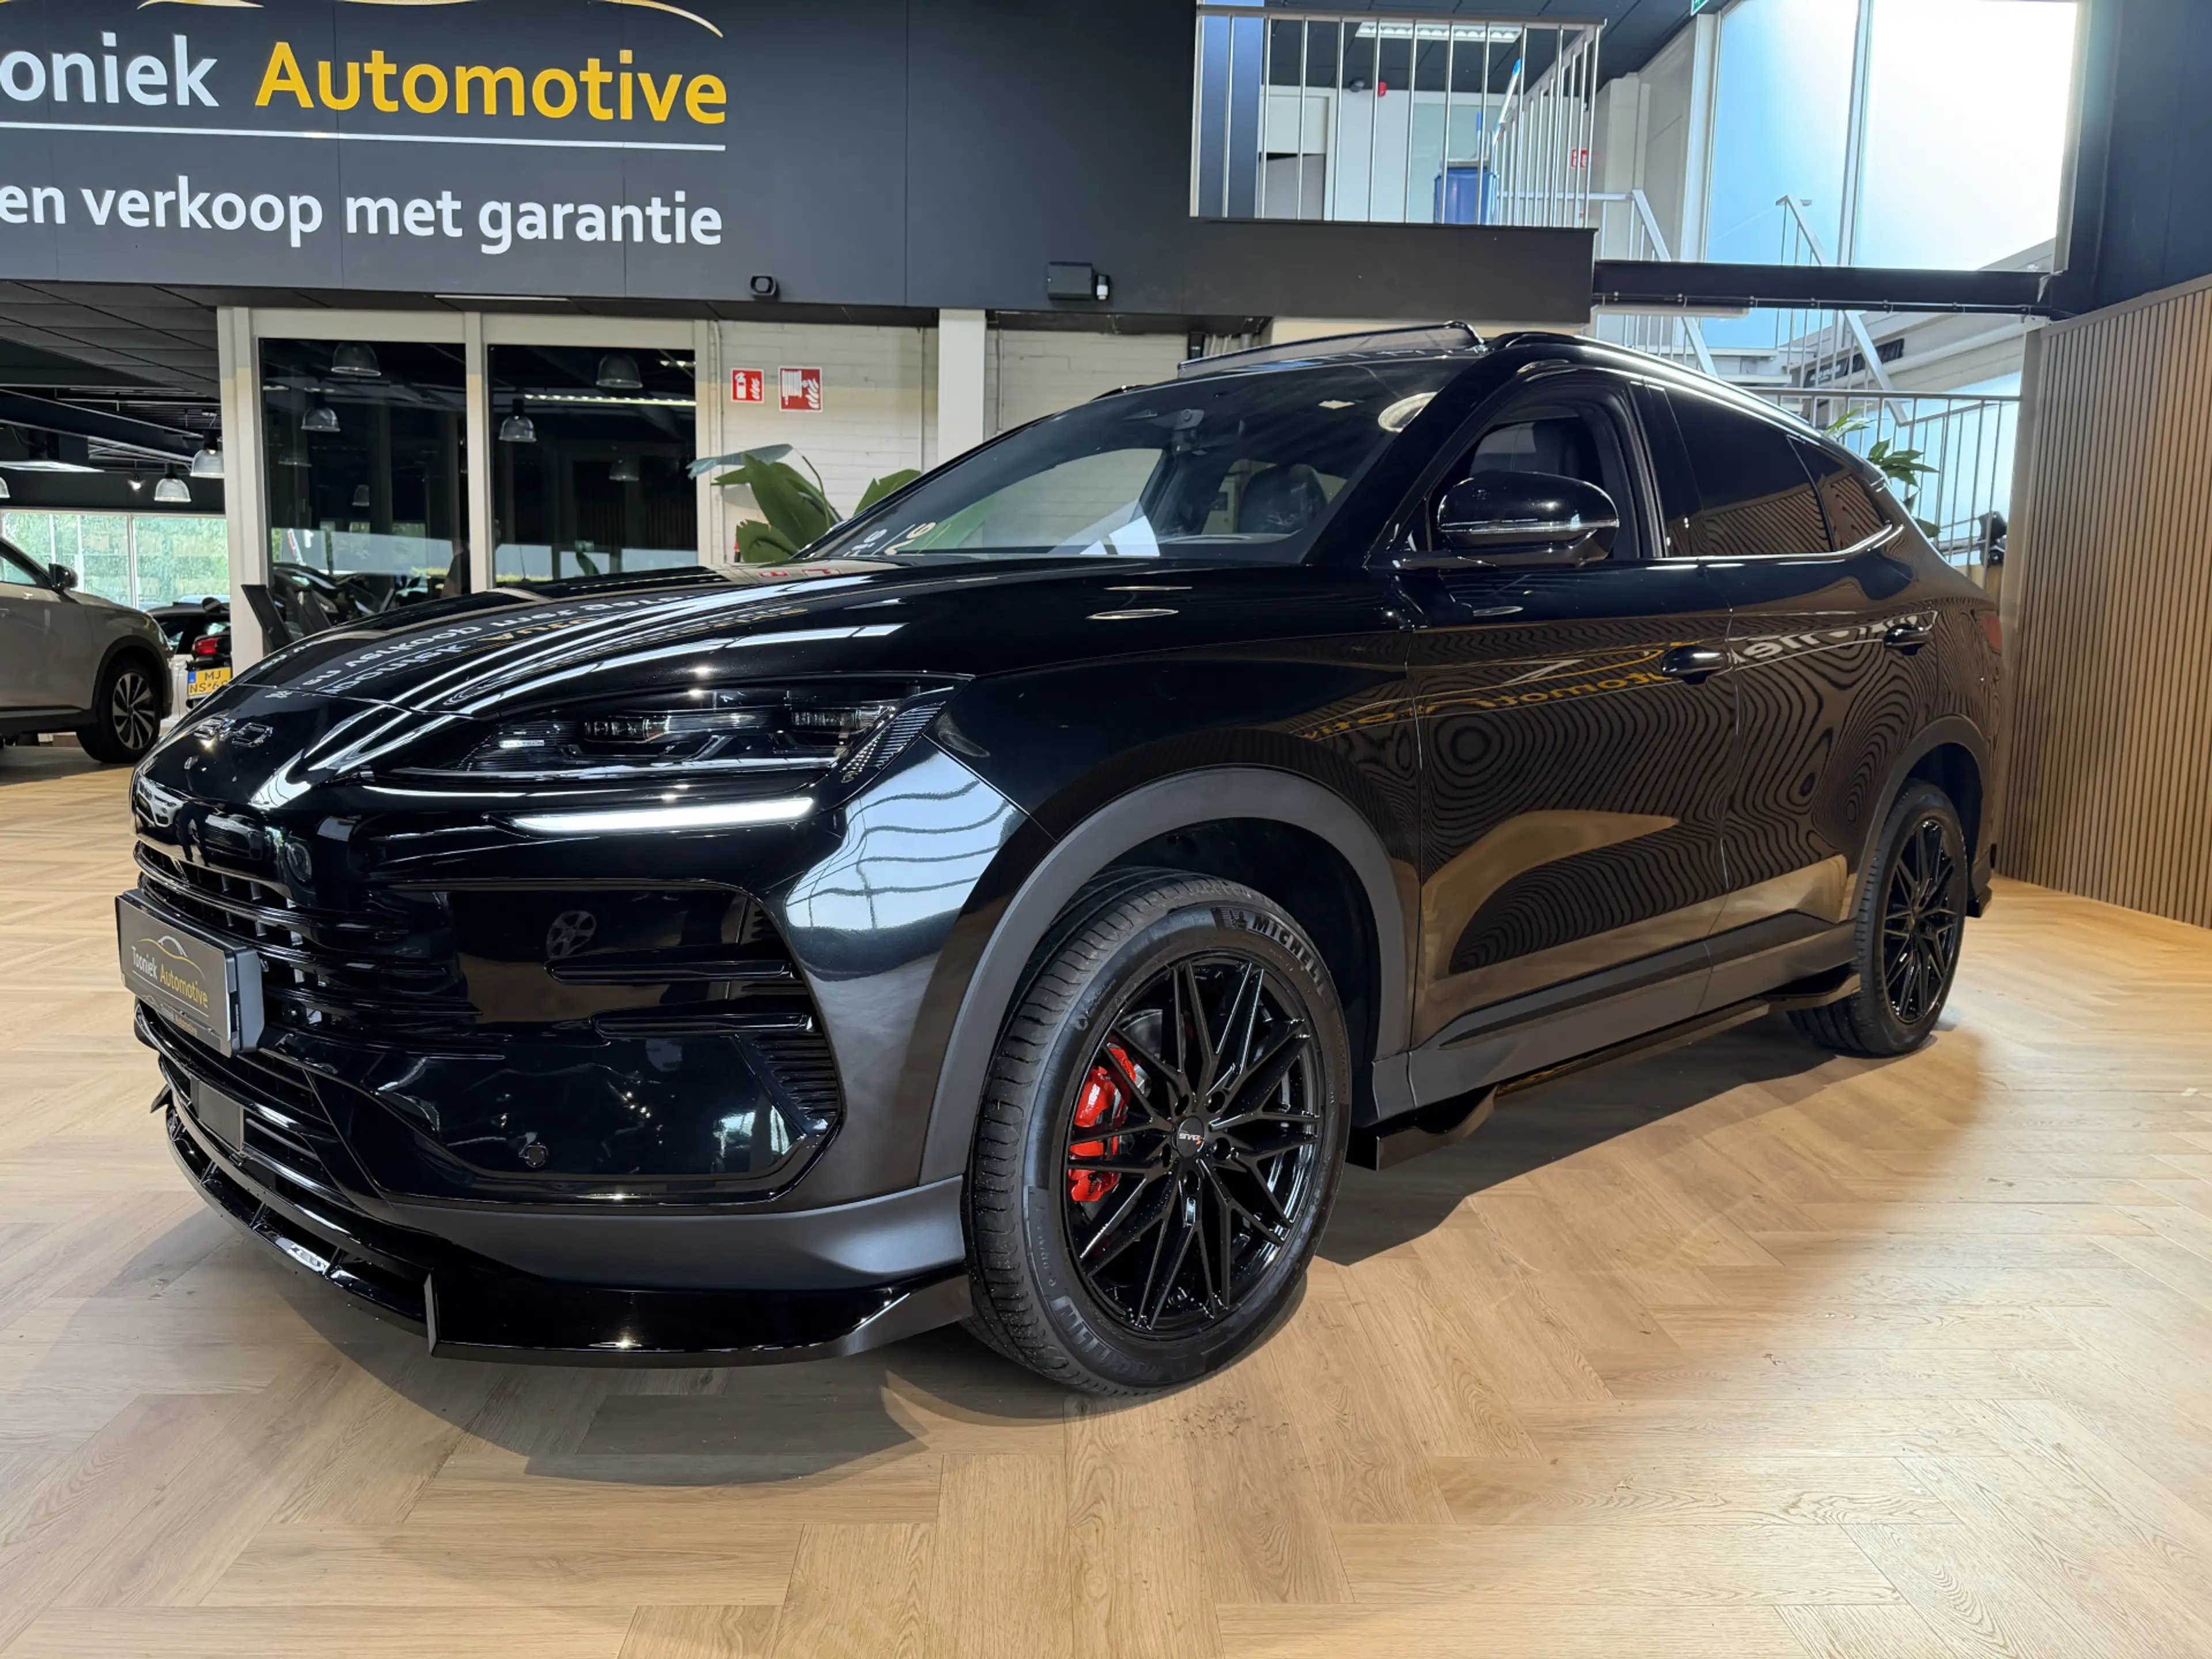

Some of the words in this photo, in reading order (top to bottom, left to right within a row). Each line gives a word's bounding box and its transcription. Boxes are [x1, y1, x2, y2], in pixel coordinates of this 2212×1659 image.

[255, 41, 728, 124] Automotive
[80, 175, 323, 247] verkoop
[346, 191, 463, 237] met
[478, 190, 722, 255] garantie
[205, 670, 221, 681] MJ
[131, 945, 157, 980] Tooniek
[160, 963, 209, 1009] Automotive
